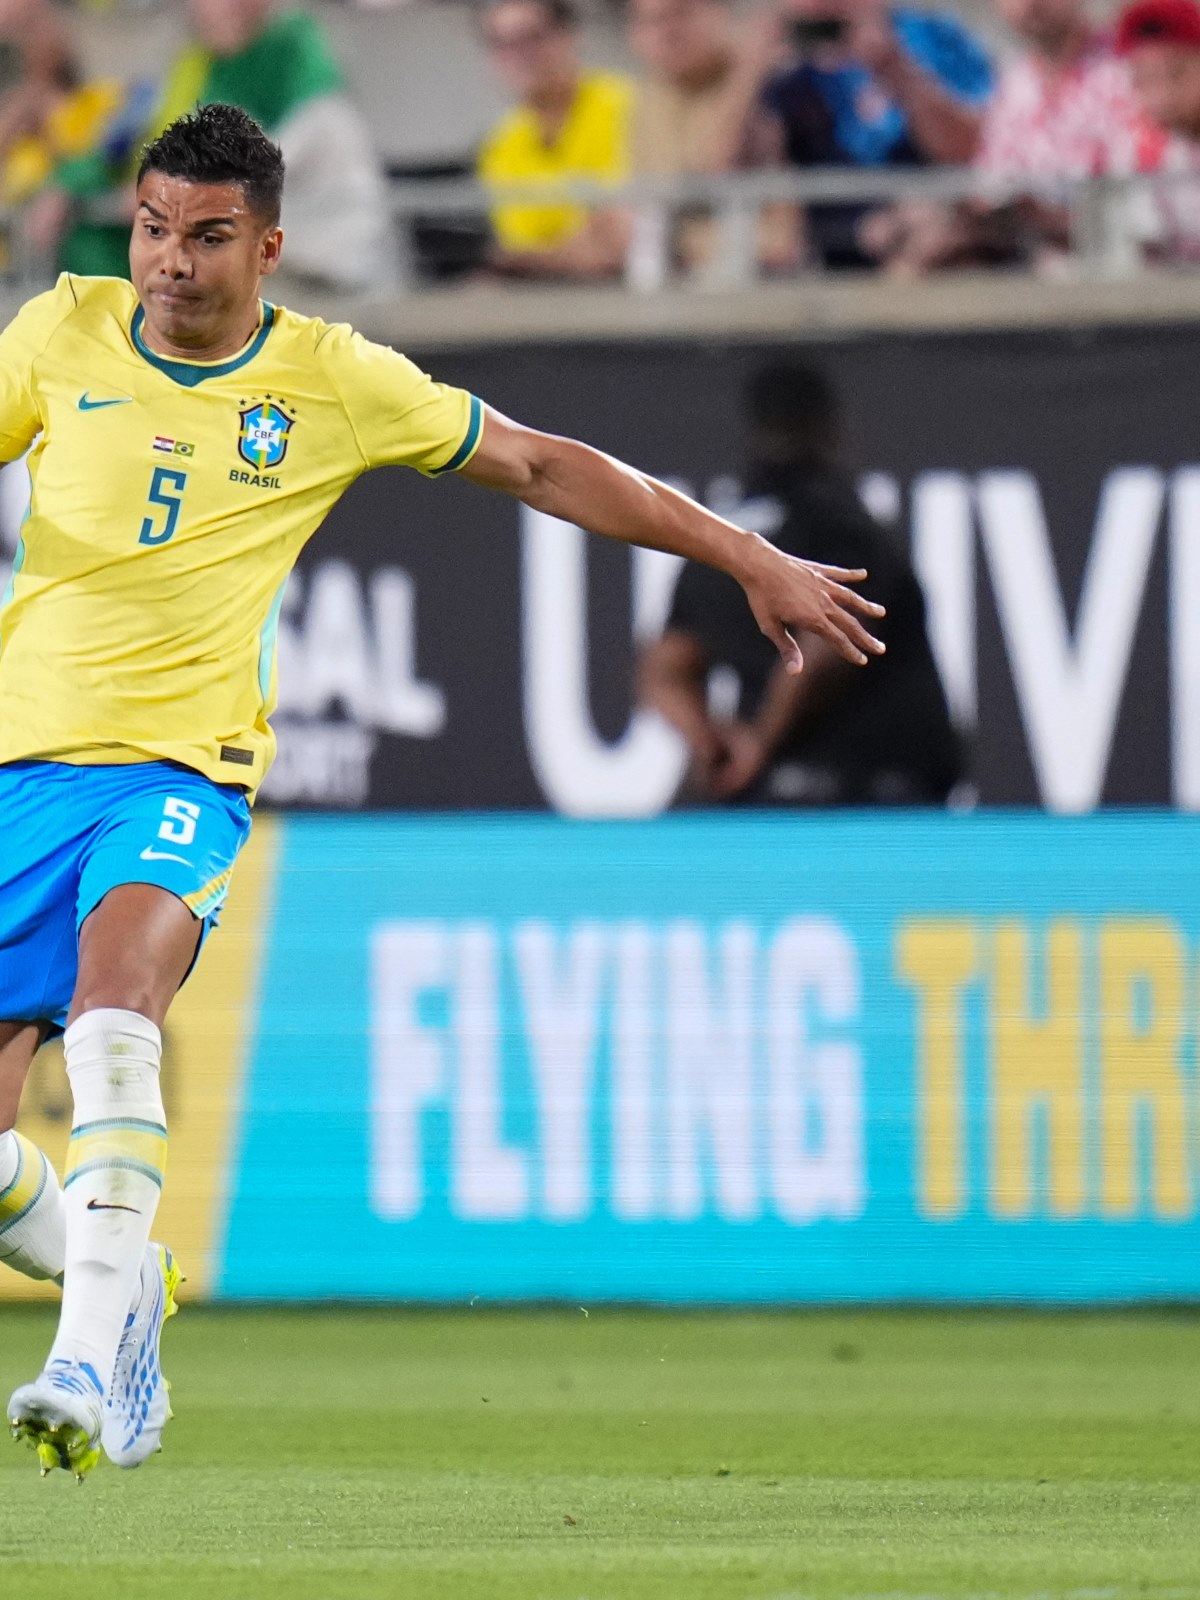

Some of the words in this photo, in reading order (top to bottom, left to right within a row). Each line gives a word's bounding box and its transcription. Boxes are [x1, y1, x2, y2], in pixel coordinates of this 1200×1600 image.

[254, 429, 274, 440] CBF
[229, 469, 281, 488] BRASIL
[138, 466, 187, 546] 5
[158, 796, 201, 845] 5
[369, 918, 867, 1225] FLYING
[895, 914, 1200, 1225] THR
